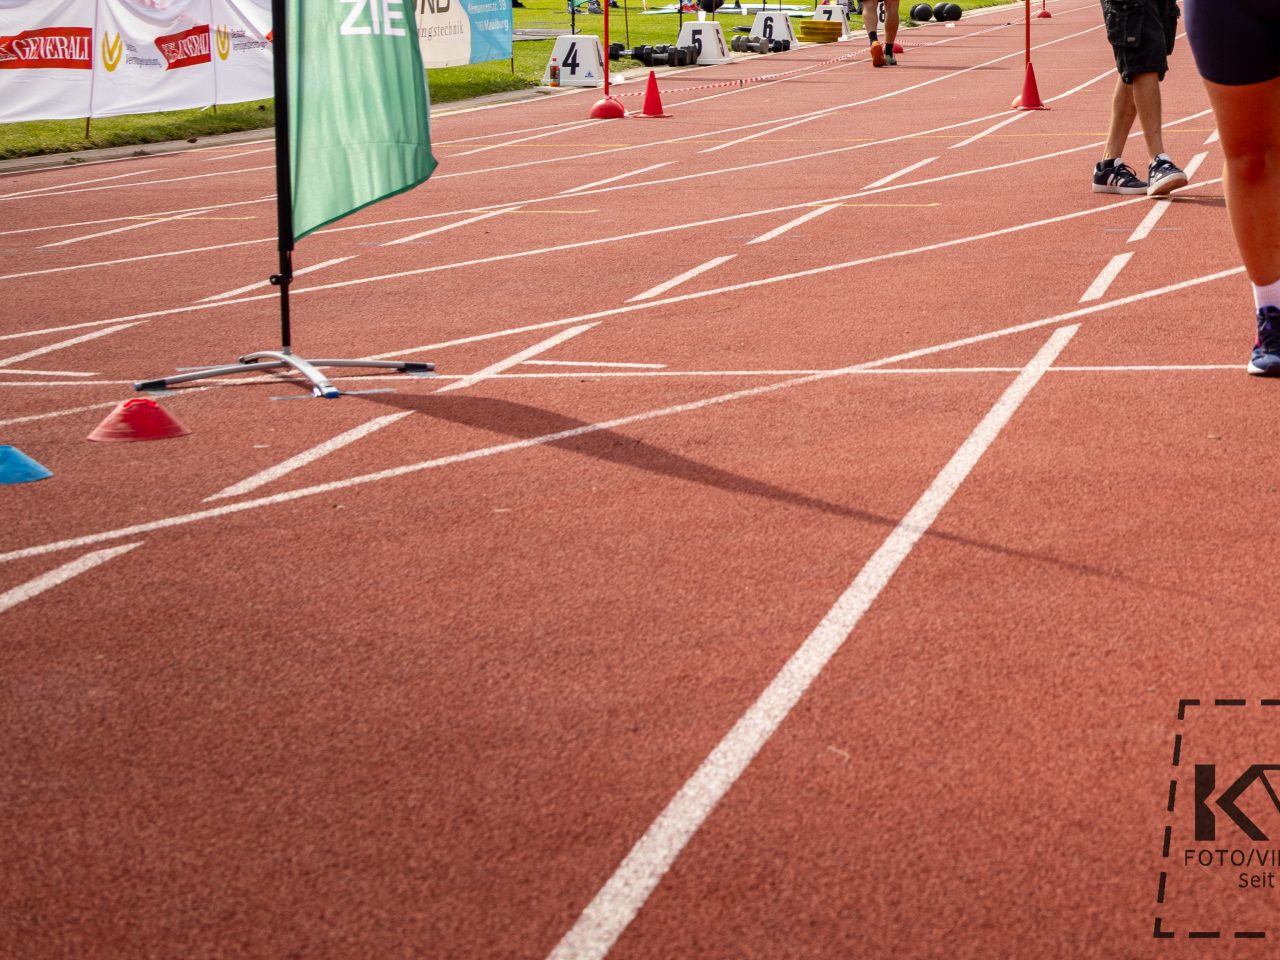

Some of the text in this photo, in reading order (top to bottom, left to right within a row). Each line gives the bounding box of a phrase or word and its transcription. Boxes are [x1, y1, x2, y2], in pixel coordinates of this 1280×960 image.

[692, 29, 702, 57] 5
[763, 16, 773, 43] 6
[562, 42, 579, 75] 4
